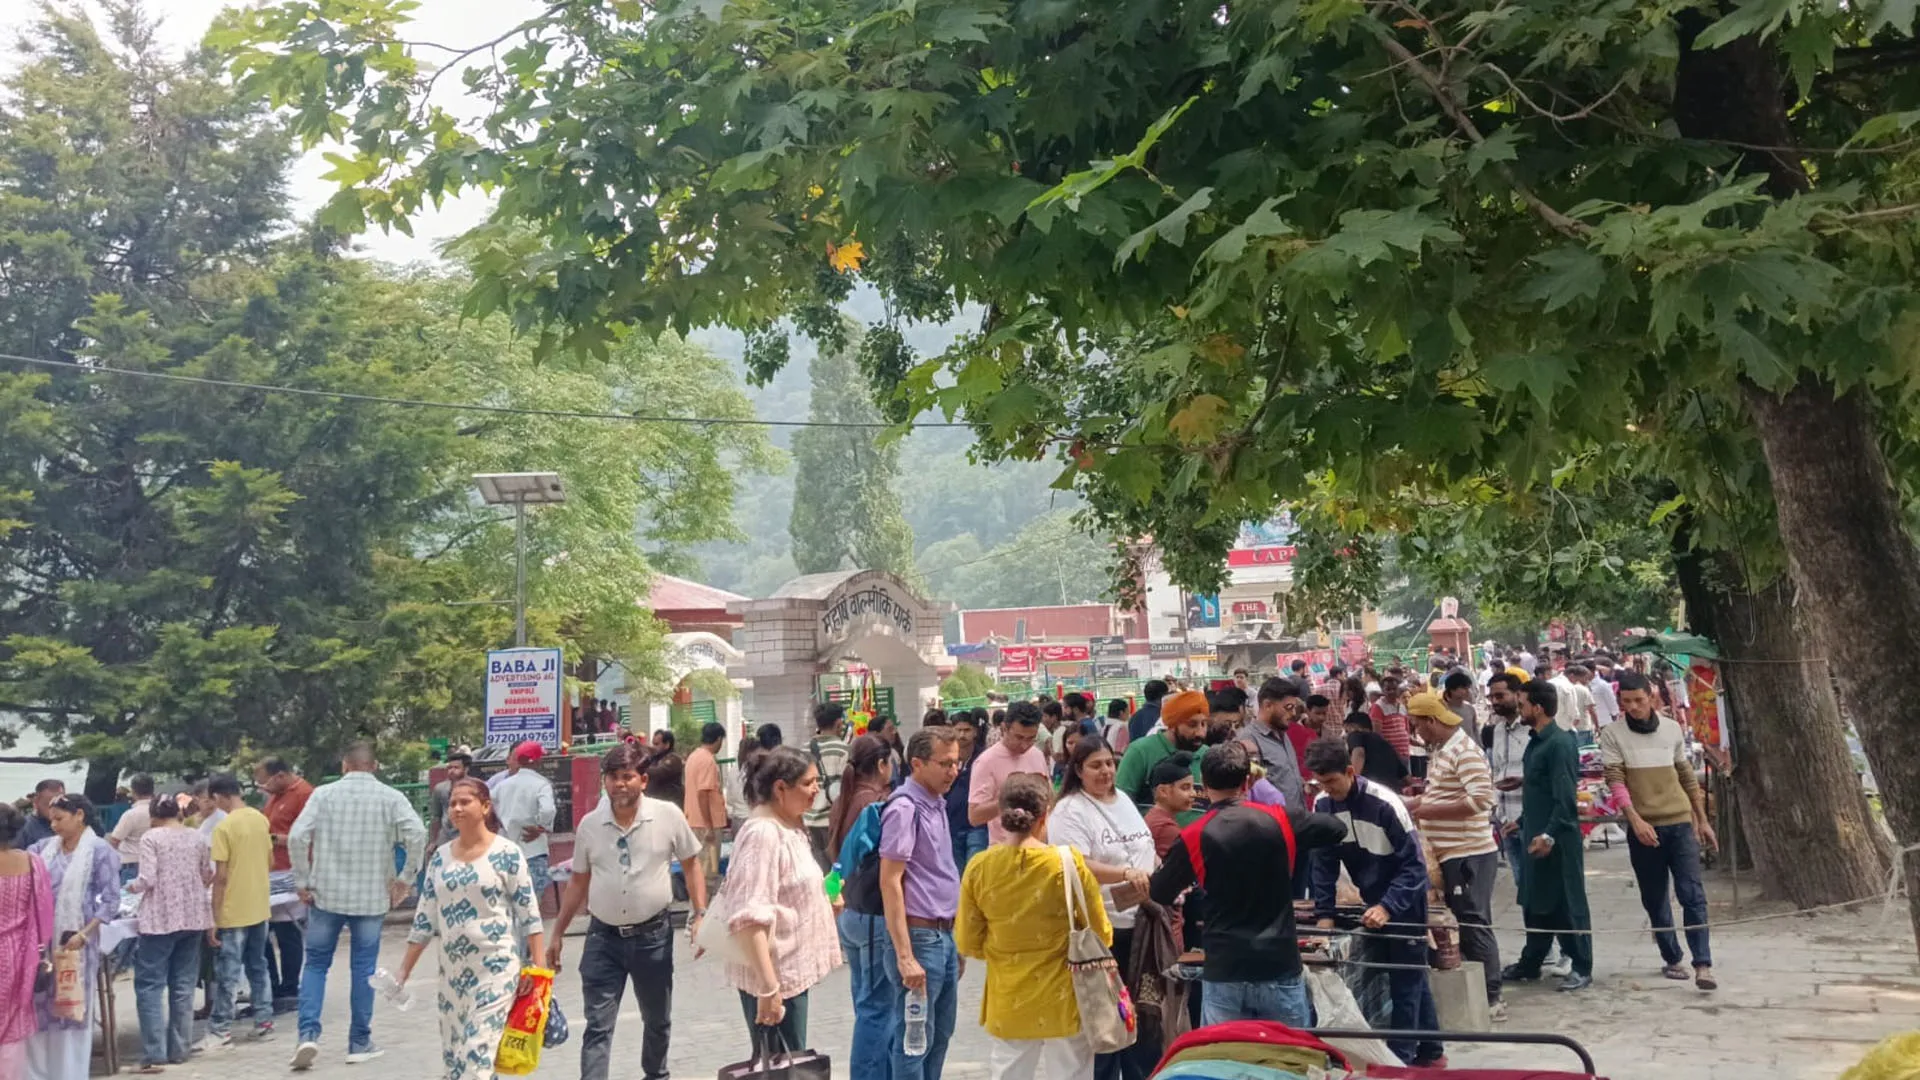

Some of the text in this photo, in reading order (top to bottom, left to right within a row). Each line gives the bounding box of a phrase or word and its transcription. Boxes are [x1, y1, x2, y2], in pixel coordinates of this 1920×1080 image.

[849, 584, 894, 617] वाल्मीकि
[893, 601, 913, 634] पार्क
[1240, 603, 1259, 611] THE
[491, 658, 555, 674] BABA JI
[490, 673, 541, 683] ADVERTISING
[487, 732, 556, 744] 9720149769
